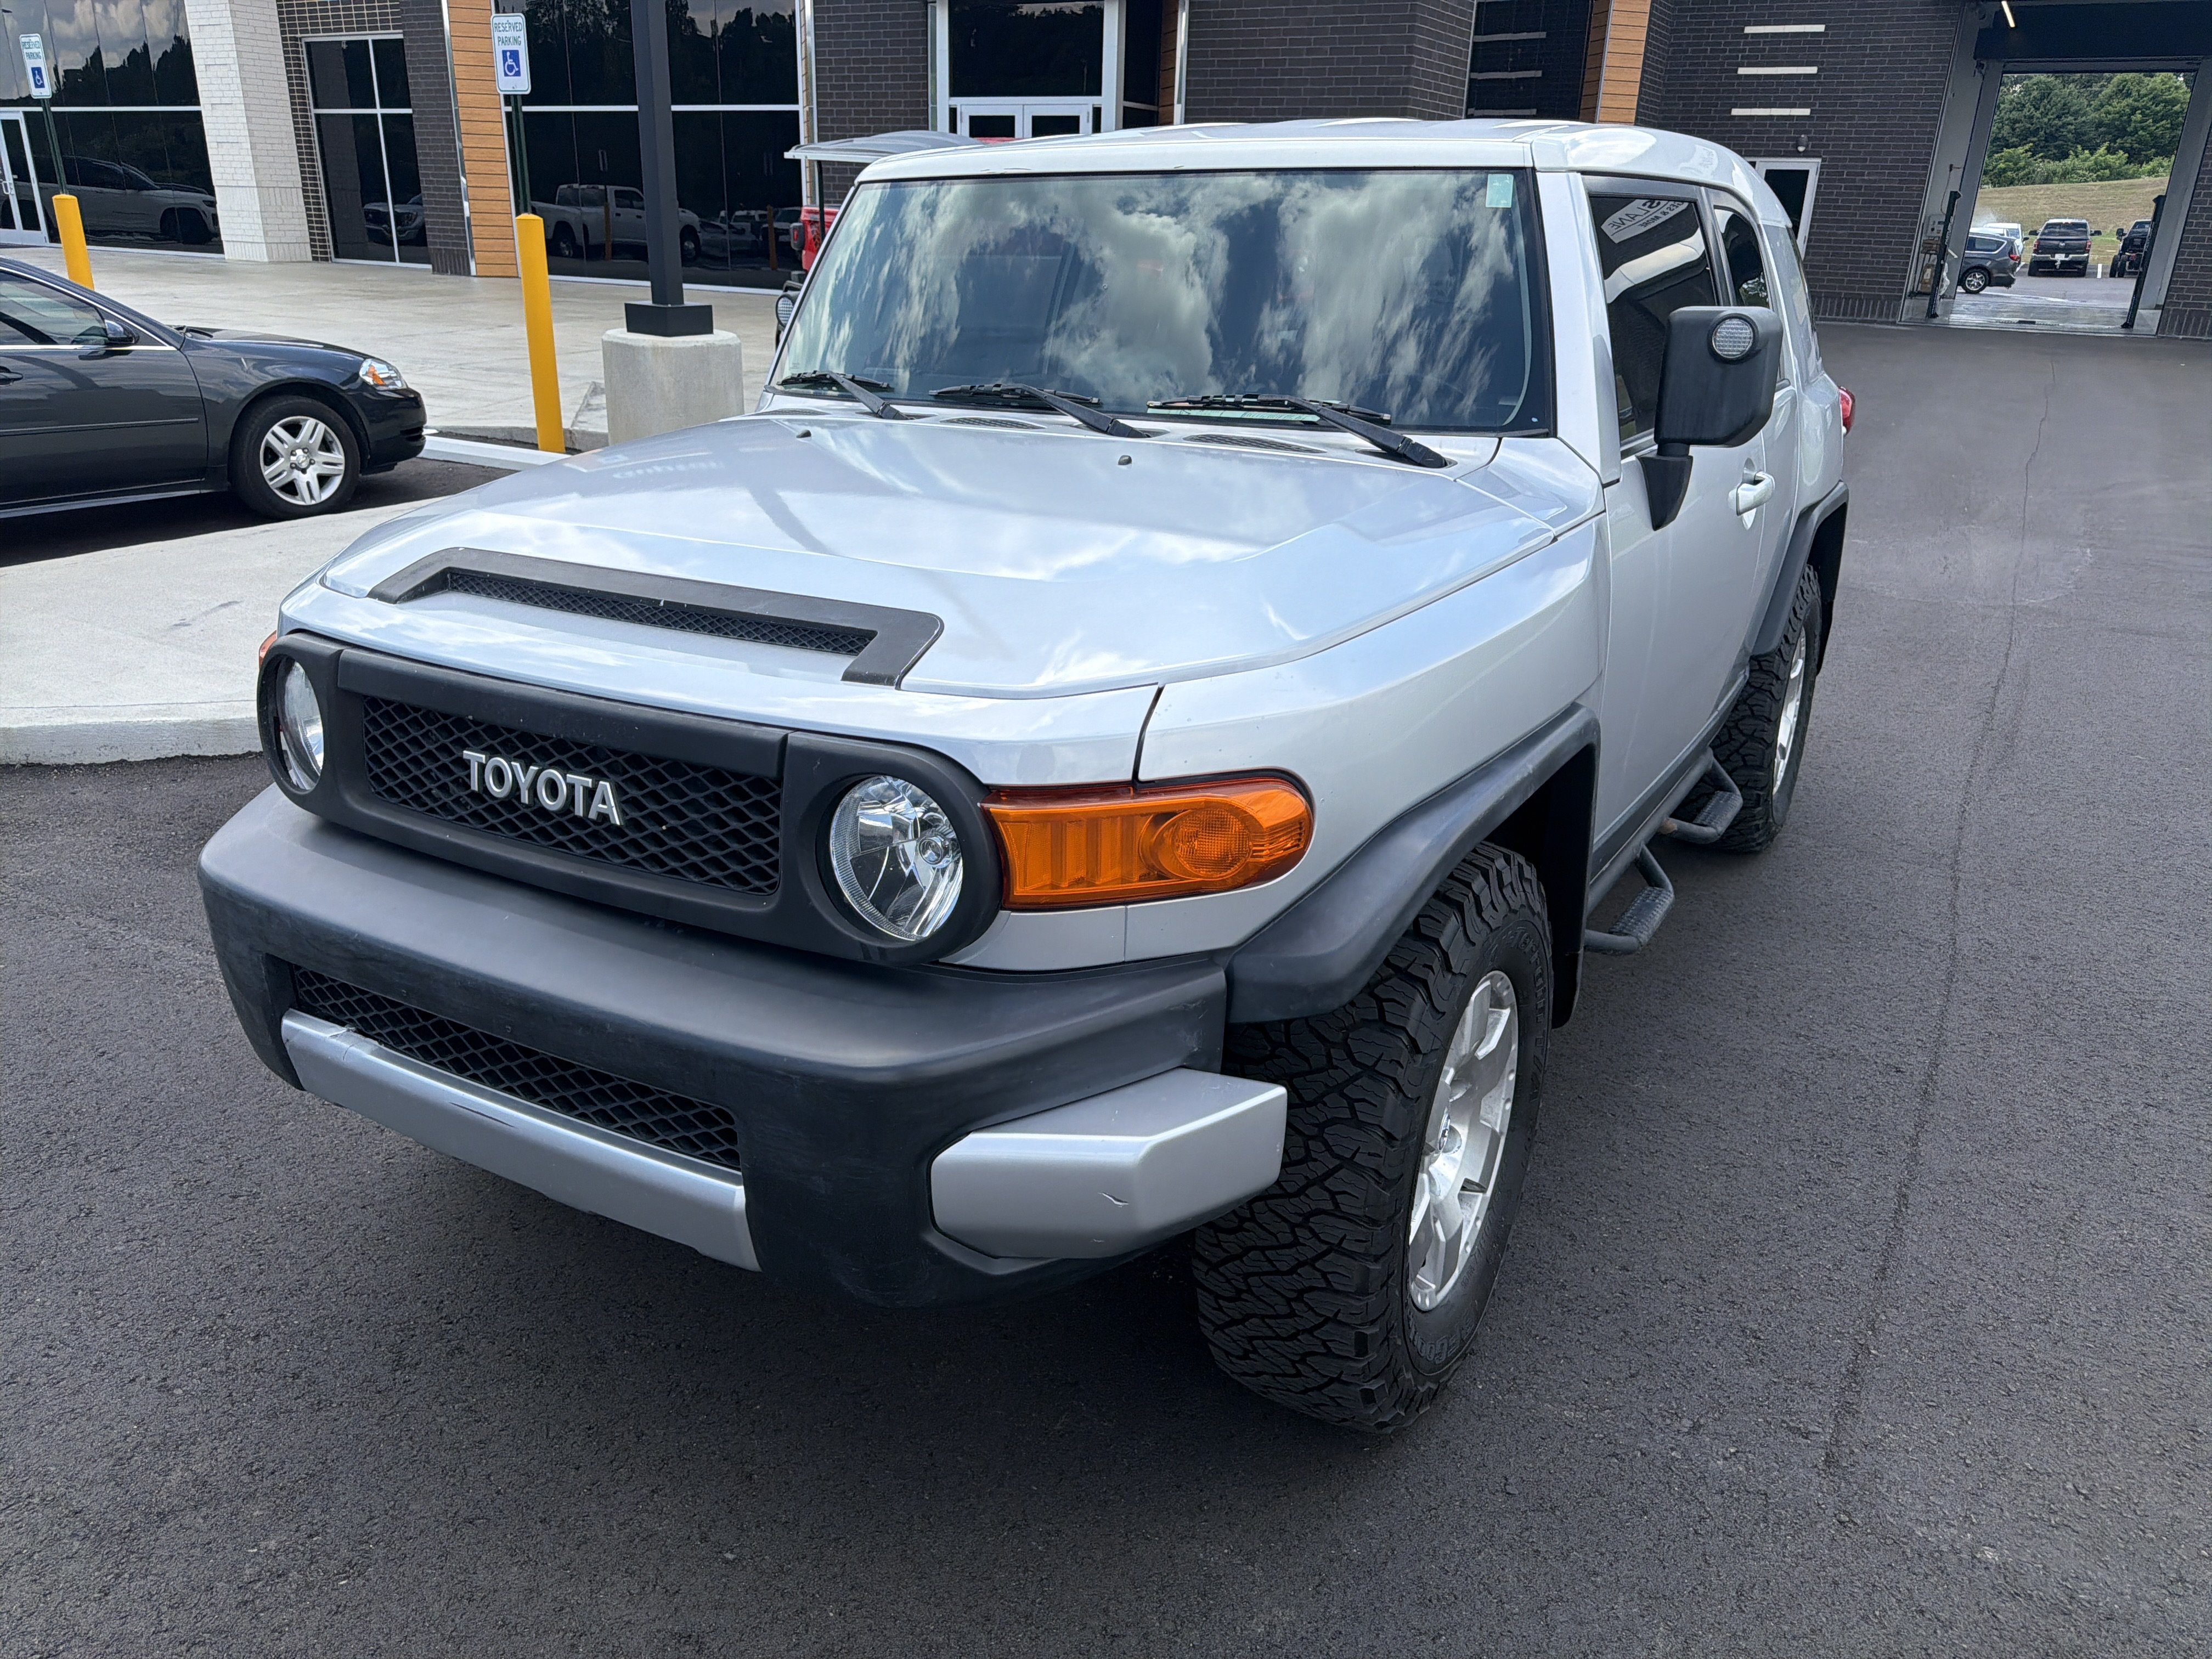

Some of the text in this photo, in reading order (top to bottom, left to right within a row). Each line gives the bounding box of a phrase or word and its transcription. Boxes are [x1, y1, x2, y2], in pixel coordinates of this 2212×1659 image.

[494, 21, 523, 33] RESERVED
[497, 35, 522, 46] PARKING
[462, 750, 623, 826] TOYOTA
